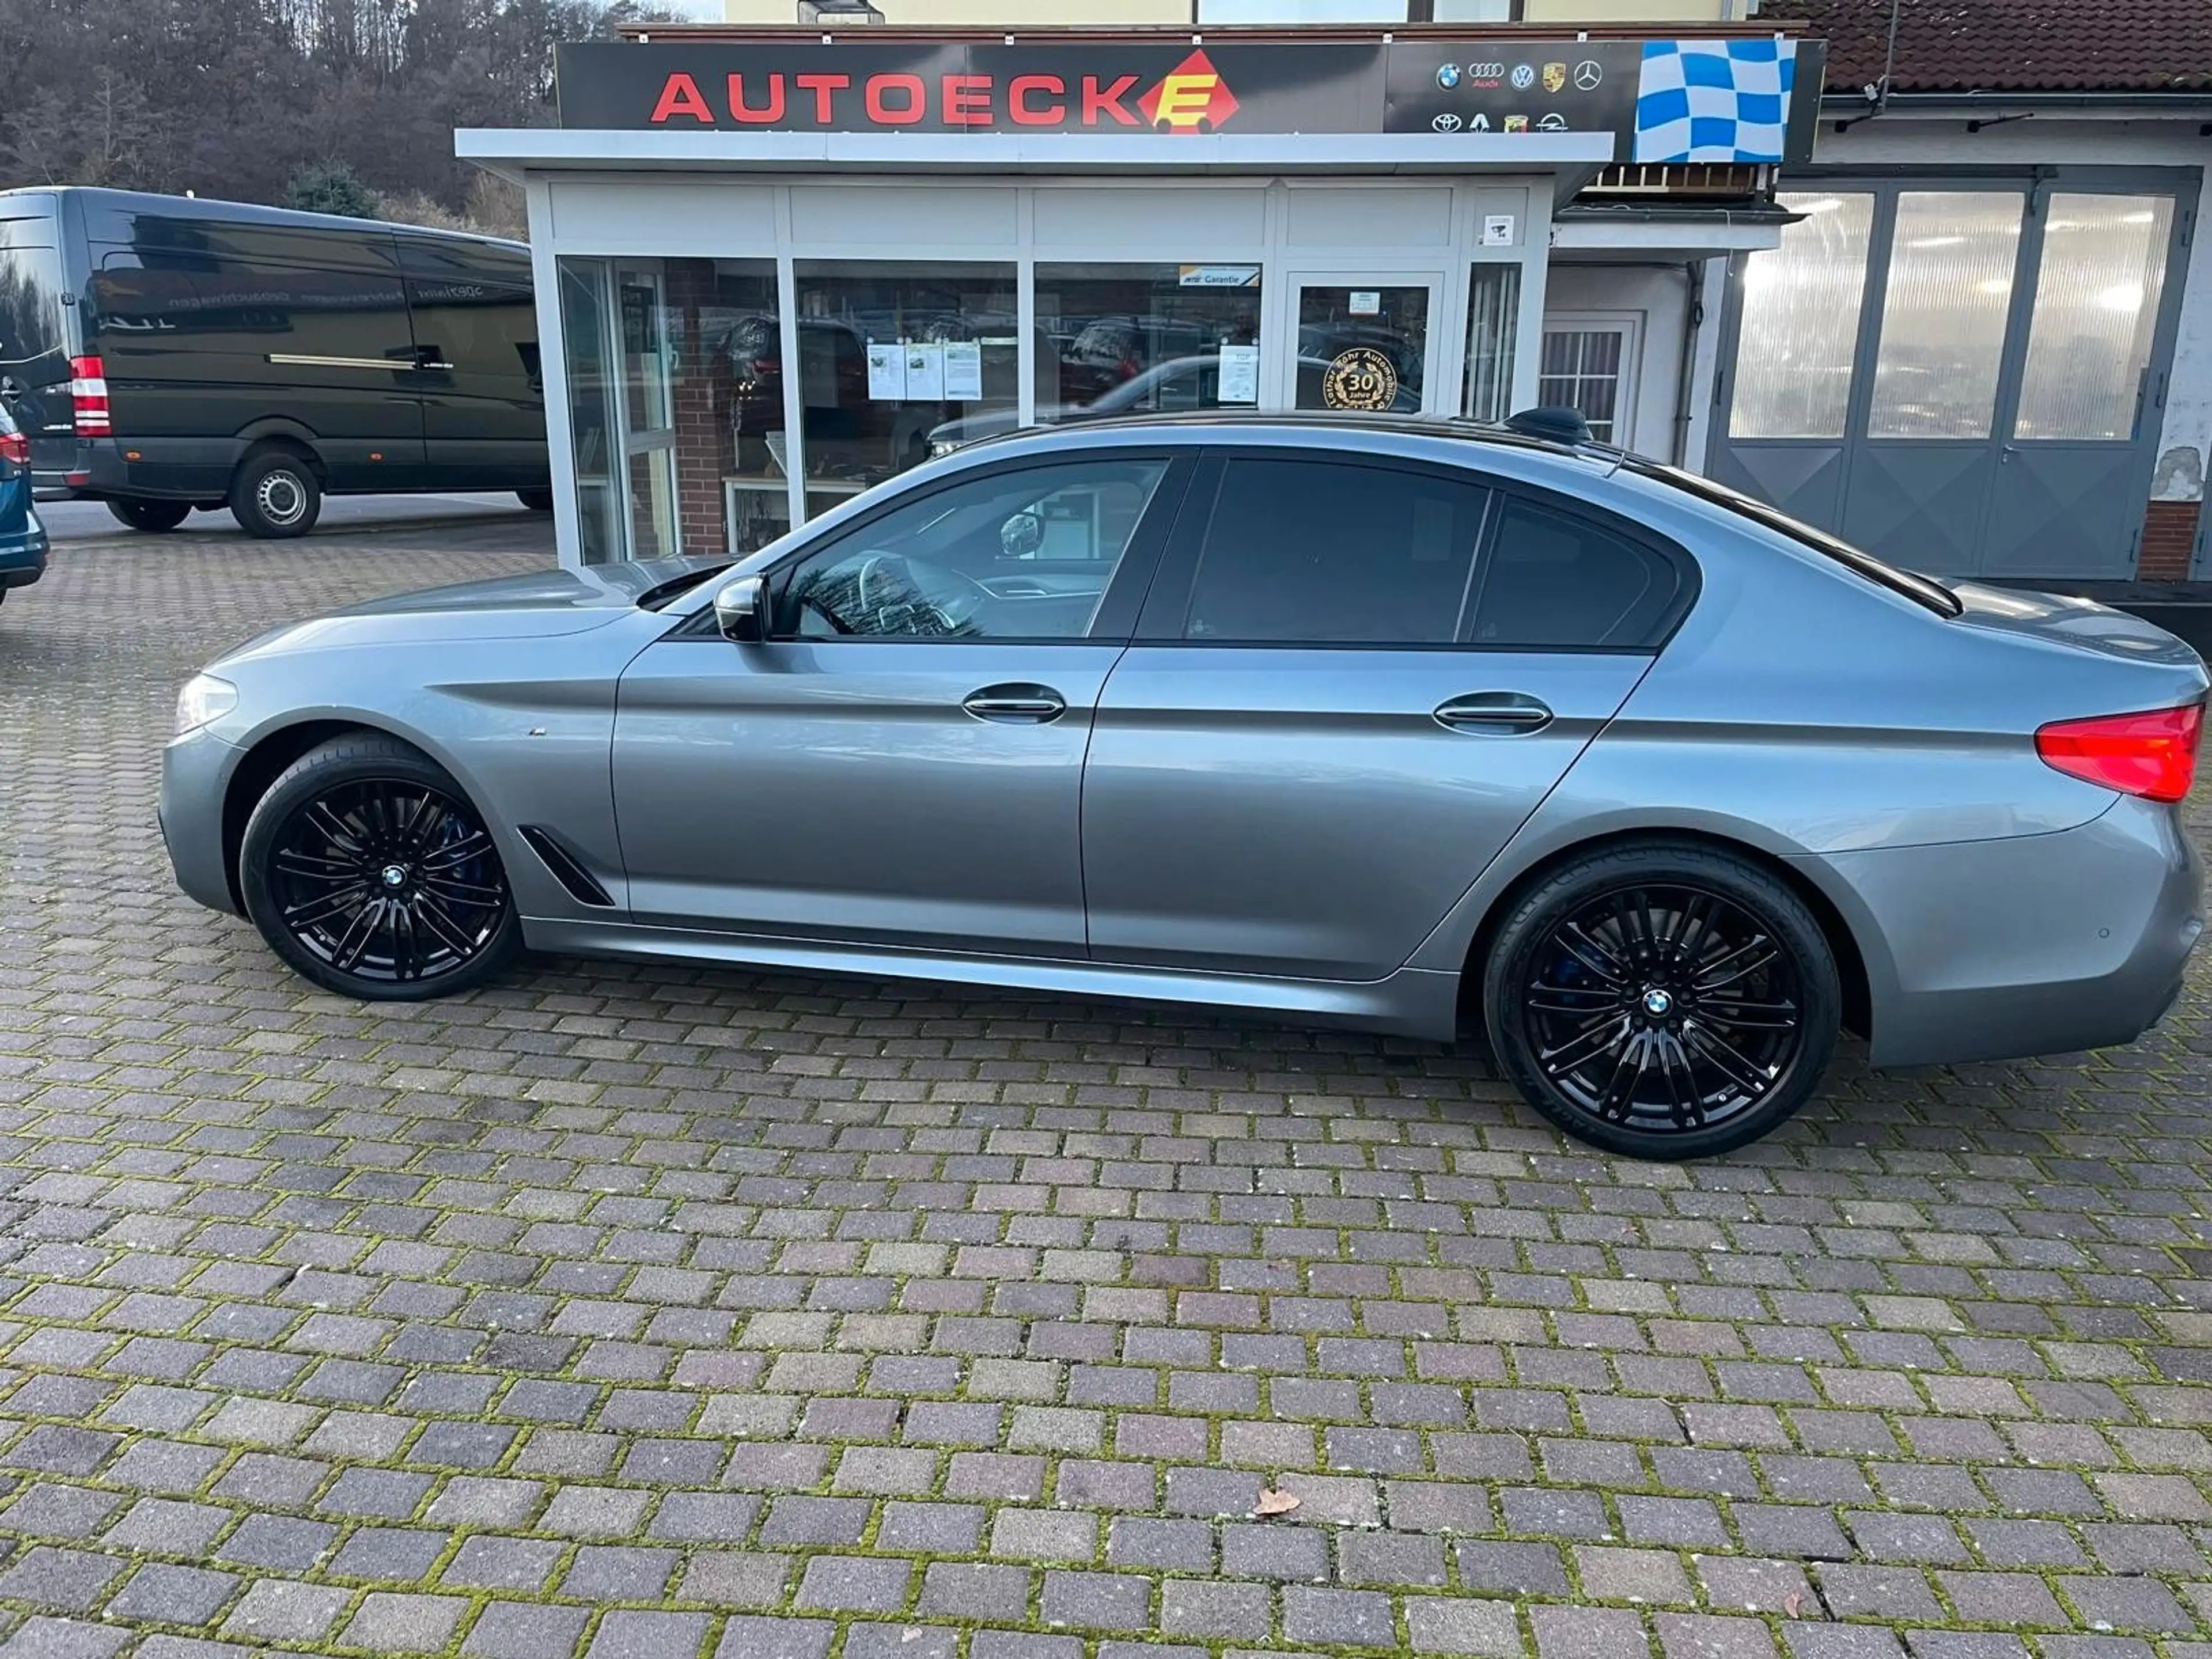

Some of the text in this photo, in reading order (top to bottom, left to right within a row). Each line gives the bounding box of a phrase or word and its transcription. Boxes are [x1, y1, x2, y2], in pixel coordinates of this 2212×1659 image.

[1472, 79, 1499, 89] Audi
[1205, 275, 1240, 284] Garantie
[1348, 374, 1374, 391] 30
[1363, 351, 1394, 401] Automobile
